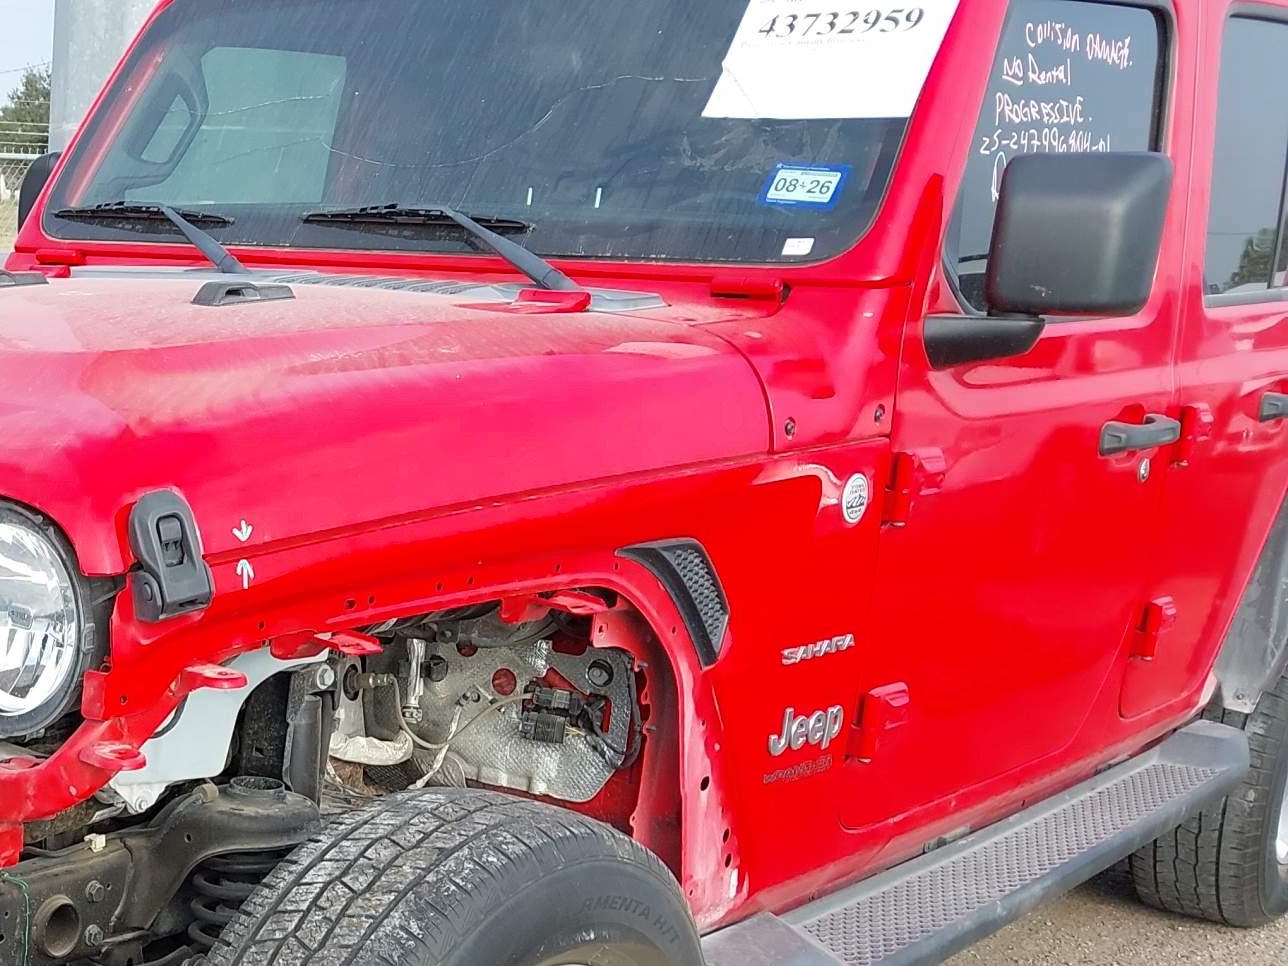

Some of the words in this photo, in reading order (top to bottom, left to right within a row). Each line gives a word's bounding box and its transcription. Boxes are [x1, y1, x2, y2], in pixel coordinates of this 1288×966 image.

[758, 8, 924, 38] 43732959
[1028, 53, 1071, 86] Rental
[774, 177, 799, 192] 08
[806, 179, 833, 194] 26
[780, 633, 855, 665] SAHARA
[768, 704, 843, 756] Jeep
